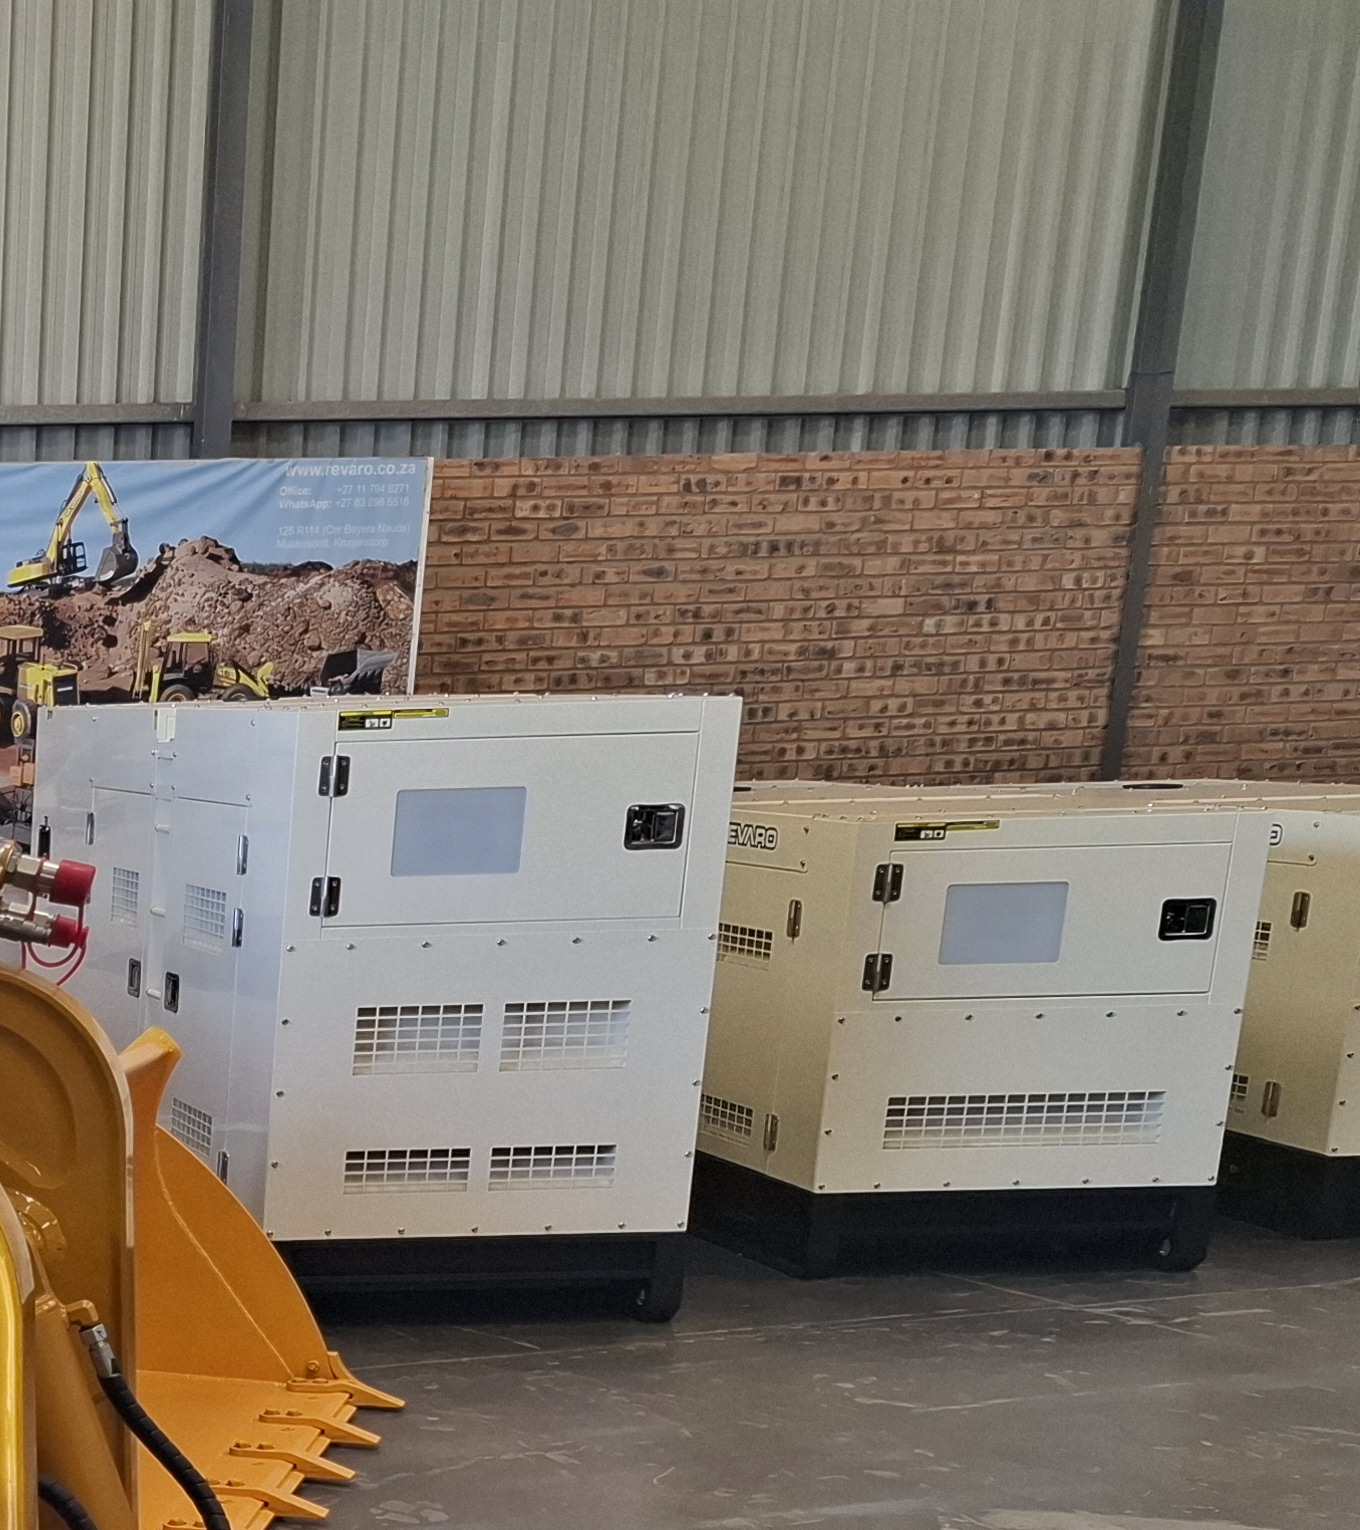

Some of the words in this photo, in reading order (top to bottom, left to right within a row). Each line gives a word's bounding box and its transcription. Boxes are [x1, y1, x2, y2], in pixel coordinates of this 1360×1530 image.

[285, 463, 416, 477] www.revaro.co.za
[337, 484, 354, 495] +27
[280, 499, 332, 510] WhatsApp:
[728, 822, 778, 850] EVARO
